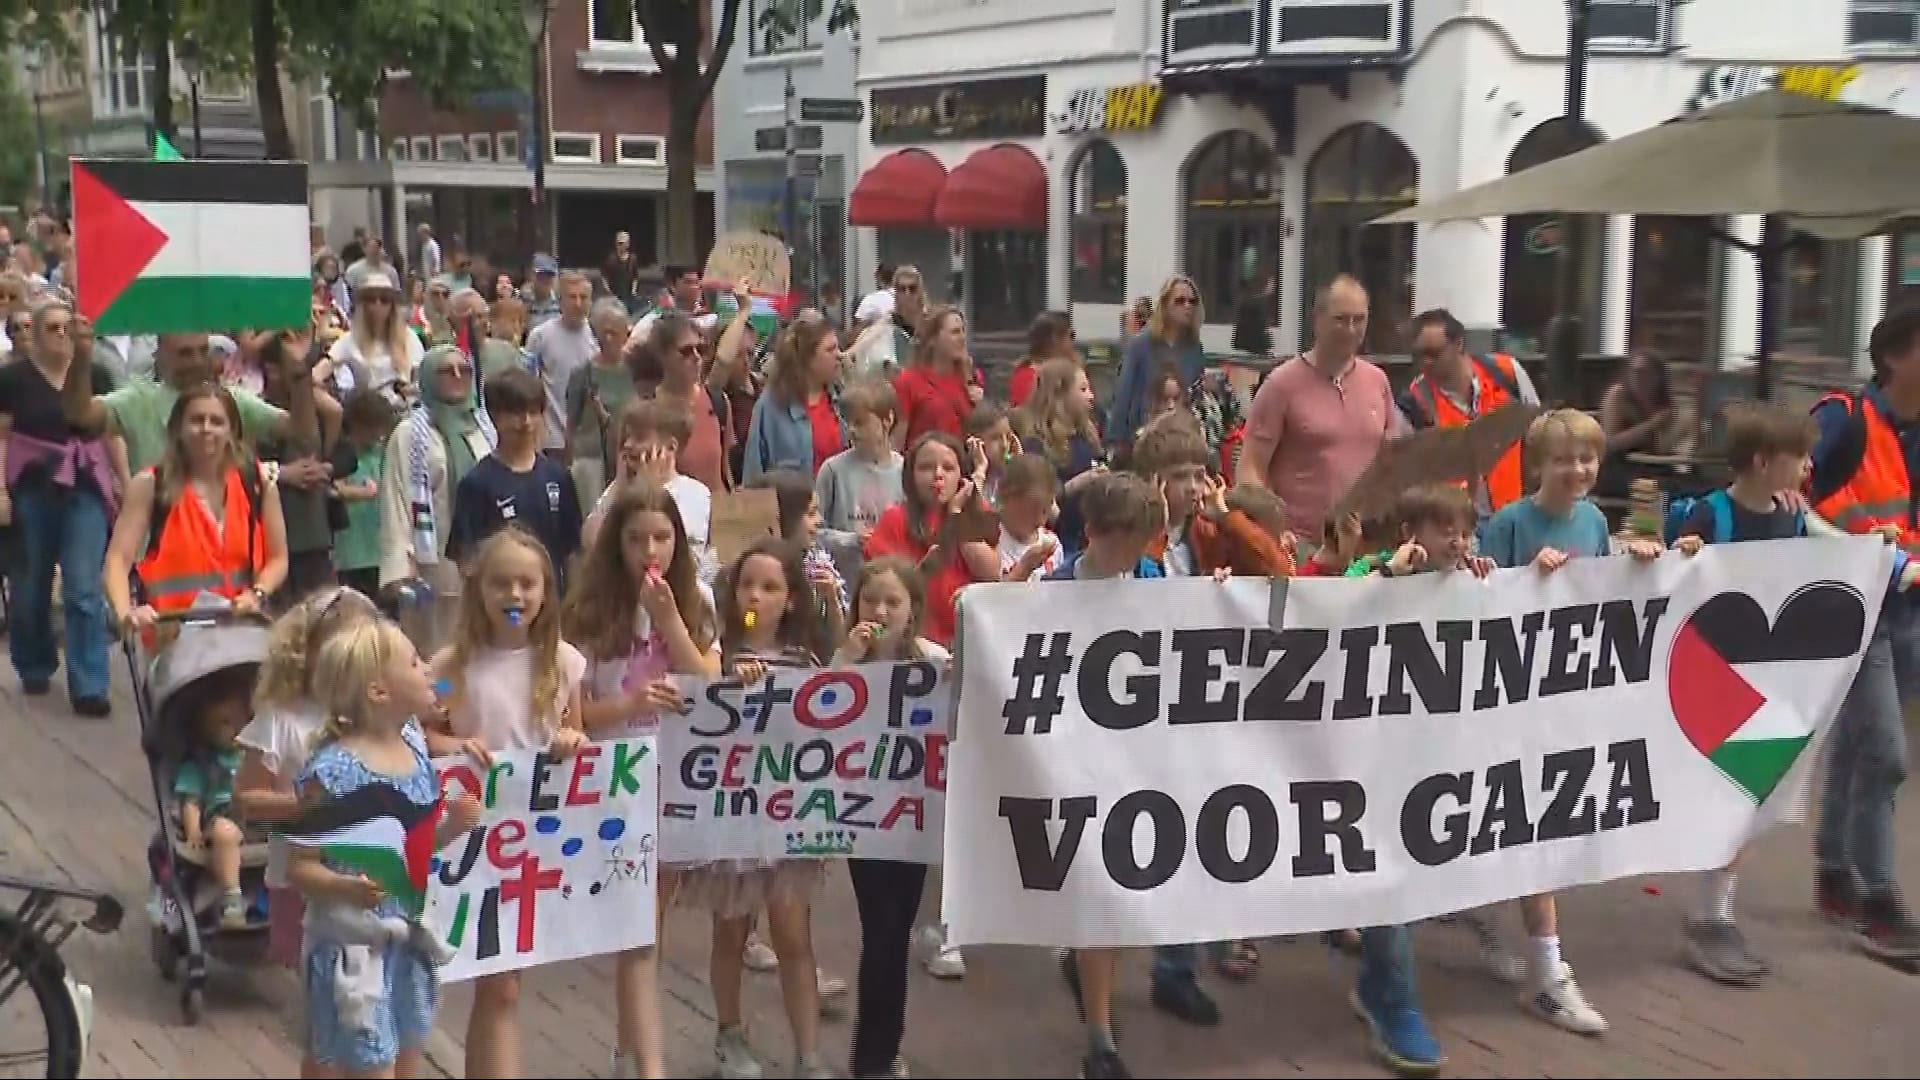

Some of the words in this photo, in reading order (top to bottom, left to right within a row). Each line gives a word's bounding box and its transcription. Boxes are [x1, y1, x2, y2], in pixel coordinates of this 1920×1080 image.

[1053, 82, 1162, 132] SUBWAY
[1691, 65, 1861, 110] SUBWAY
[1003, 597, 1669, 735] #GEZINNEN
[765, 789, 925, 832] GAZA
[999, 779, 1375, 891] VOOR
[1400, 738, 1660, 866] GAZA
